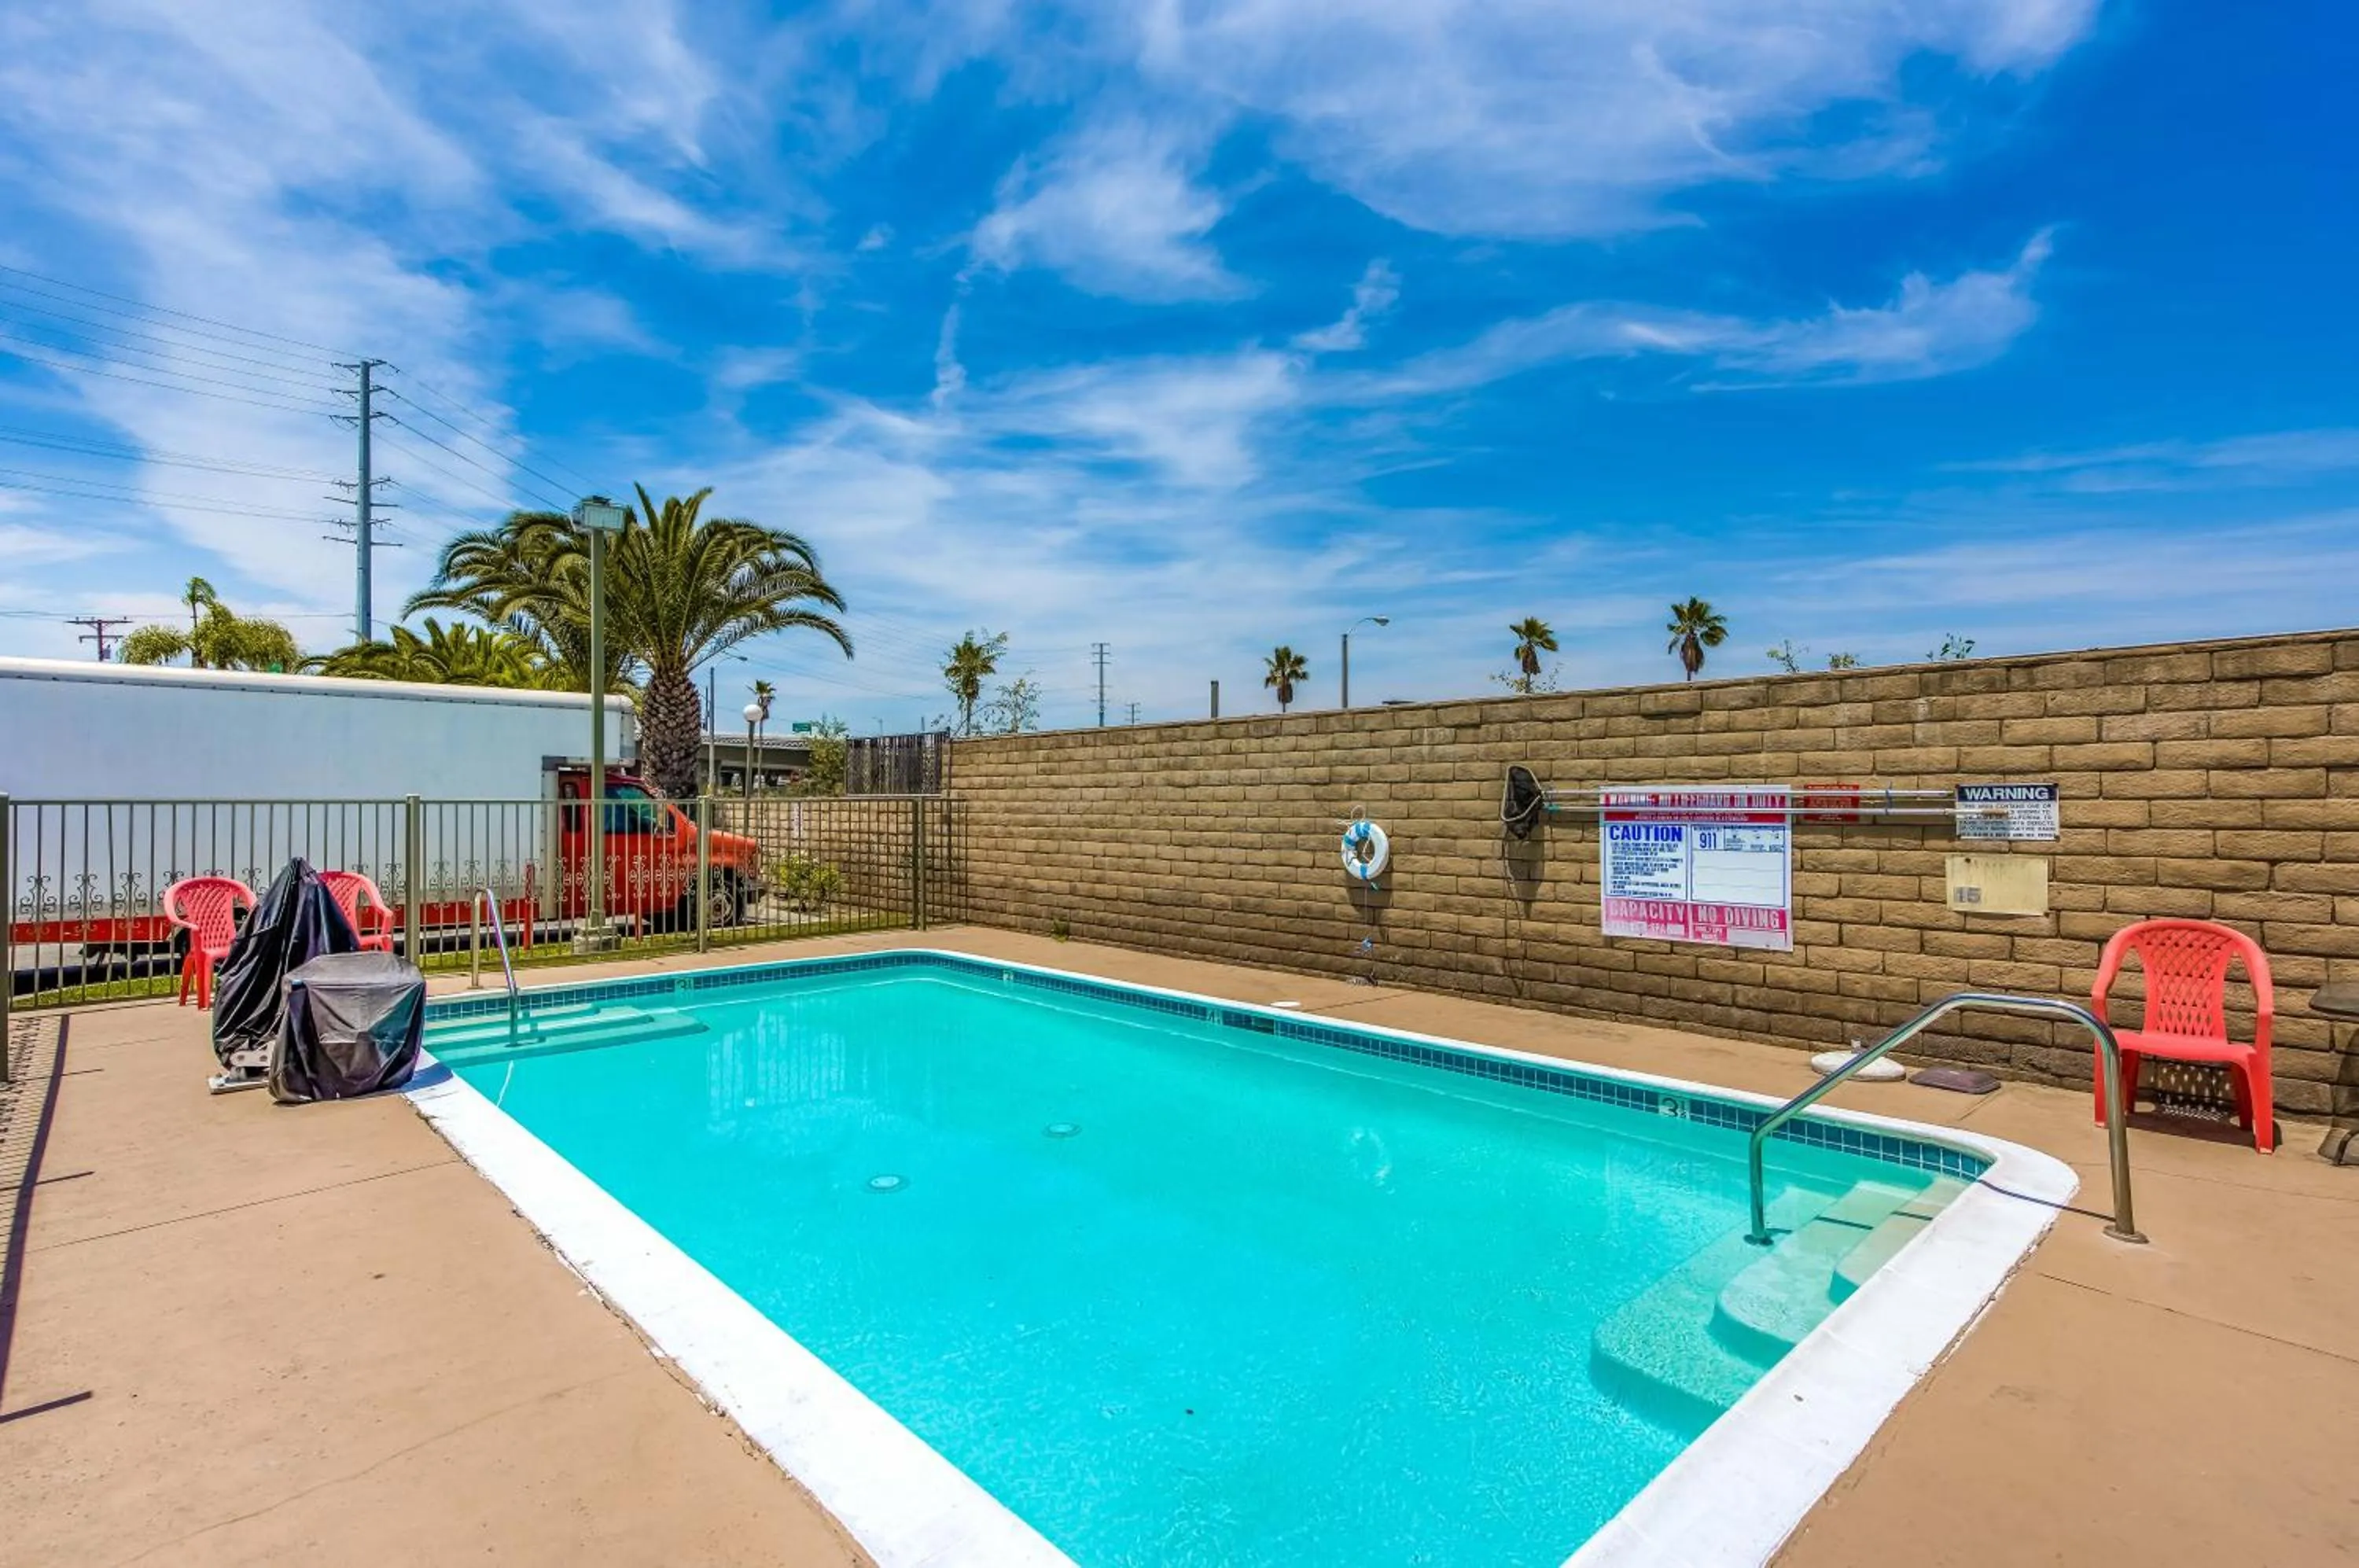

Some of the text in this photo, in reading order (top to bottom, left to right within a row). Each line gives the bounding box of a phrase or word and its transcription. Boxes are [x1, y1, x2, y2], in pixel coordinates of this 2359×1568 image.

[1964, 787, 2049, 801] WARNING
[1610, 824, 1682, 842] CAUTION
[1699, 832, 1717, 850] 911
[1956, 886, 1982, 904] 15
[1610, 900, 1685, 922] CAPACITY
[1698, 905, 1780, 929] NO DIVING
